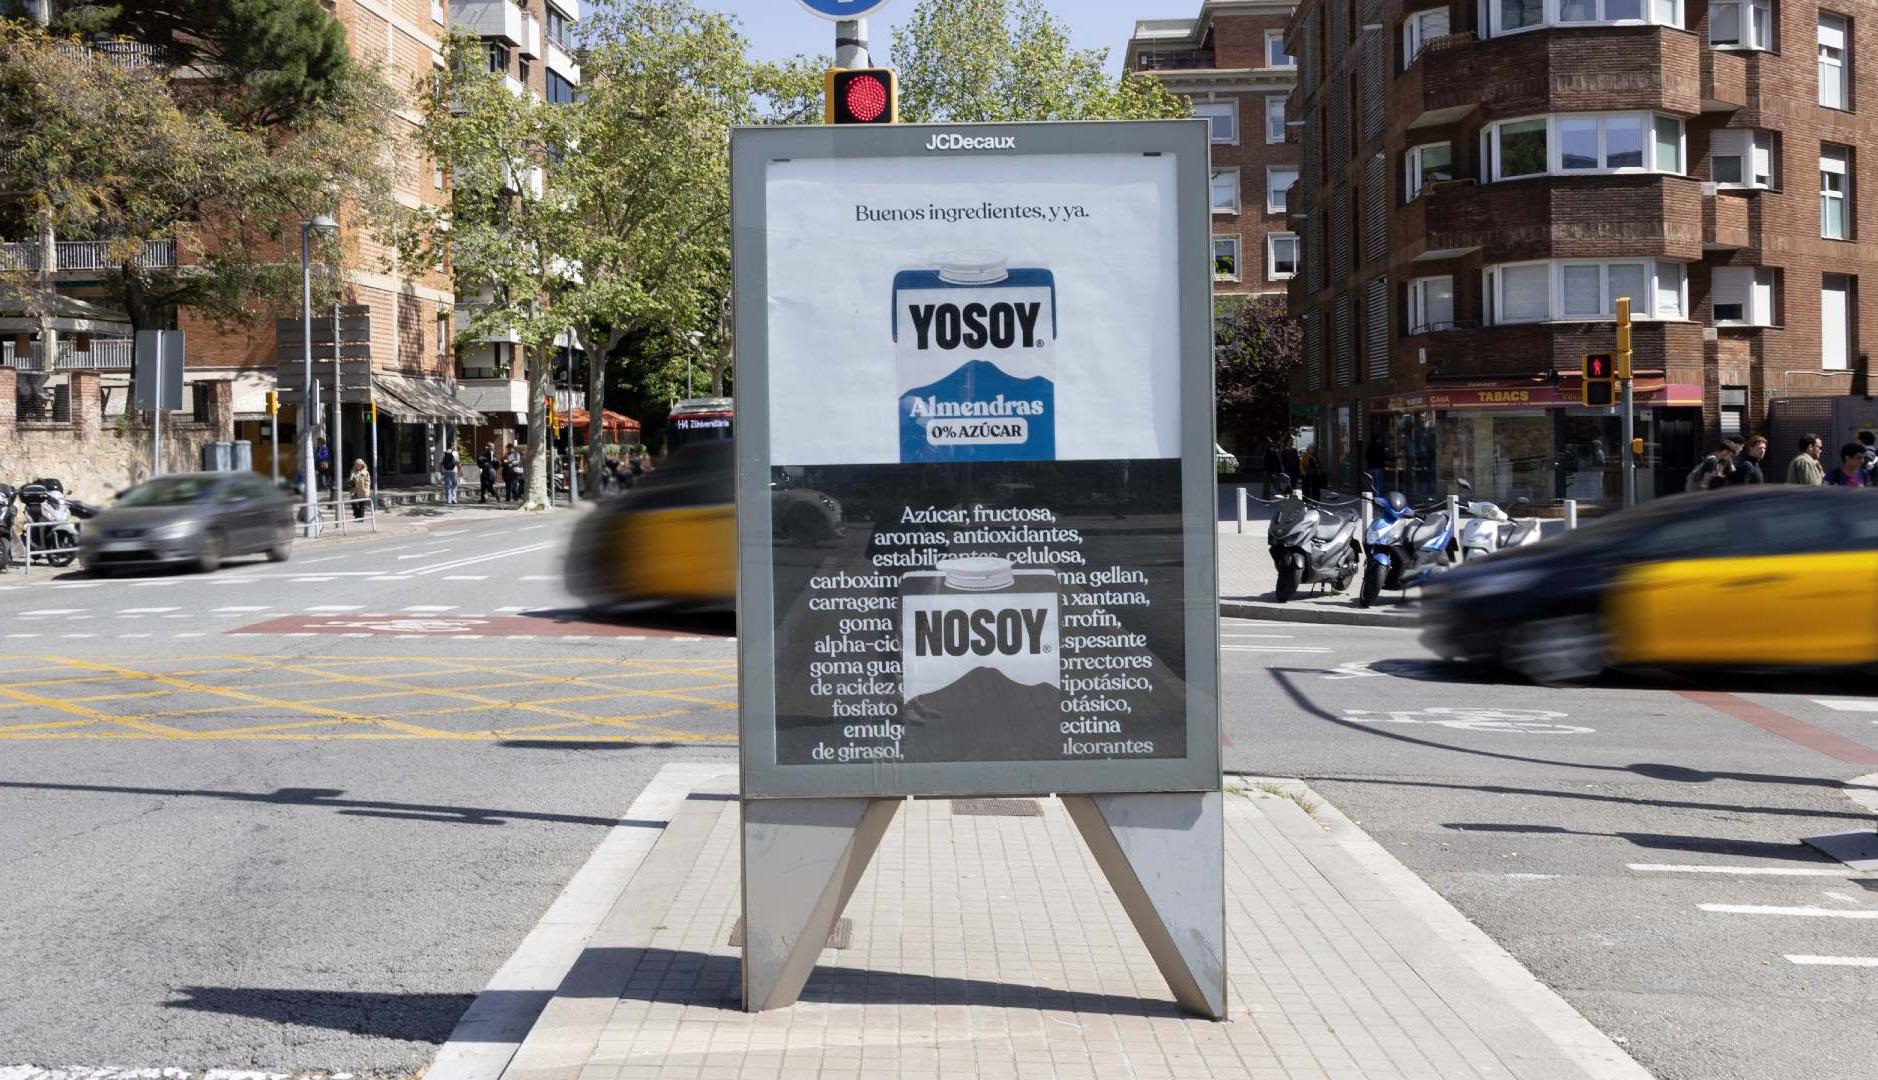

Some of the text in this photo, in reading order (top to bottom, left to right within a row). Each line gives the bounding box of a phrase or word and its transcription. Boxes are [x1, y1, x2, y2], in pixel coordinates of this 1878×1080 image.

[926, 134, 1015, 150] JCDecaux
[855, 204, 925, 221] Buenos
[929, 203, 1046, 222] ingredientes,
[1063, 206, 1090, 221] ya.
[909, 394, 1044, 417] Almendras
[1478, 390, 1529, 402] TABACS
[931, 422, 1023, 439] 0% AZÚCAR
[900, 504, 1056, 526] Azúcar, fructosa,
[874, 525, 1084, 547] aromas, antioxidantes,
[1006, 546, 1086, 566] celulosa,
[1090, 566, 1149, 588] gellan,
[1071, 589, 1151, 607] xantana,
[839, 608, 1122, 634] goma rrofín,
[814, 632, 1147, 657] alpha-cic spesante
[810, 661, 863, 677] goma
[867, 660, 904, 677] gua
[810, 678, 833, 695] de
[836, 677, 895, 695] acidez
[832, 698, 898, 717] fosfato
[1060, 715, 1122, 734] ecitina
[812, 742, 835, 760] de
[838, 741, 905, 762] girasol,
